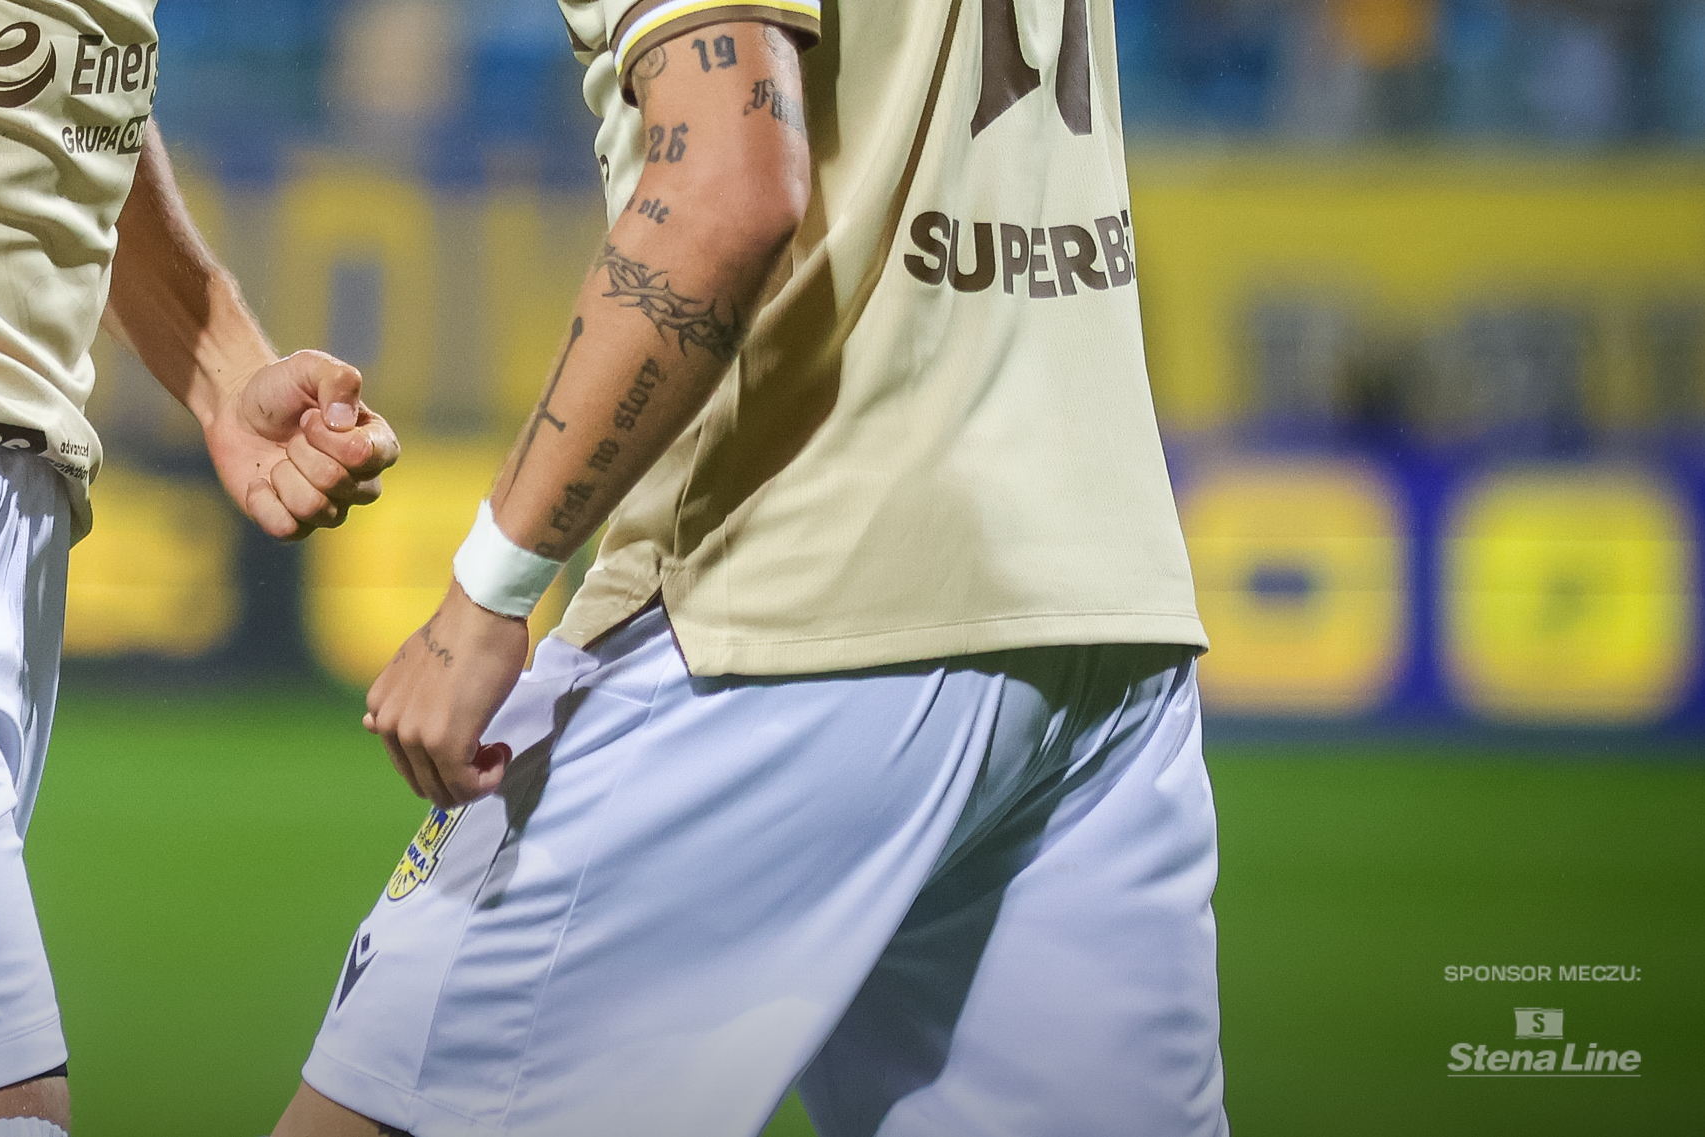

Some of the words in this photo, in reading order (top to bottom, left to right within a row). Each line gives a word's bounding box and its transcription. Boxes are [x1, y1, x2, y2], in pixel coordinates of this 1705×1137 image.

[70, 33, 157, 106] Ener
[691, 34, 737, 73] 19
[61, 126, 121, 154] GRUPA
[647, 123, 689, 164] 26
[903, 209, 1136, 299] SUPERB
[613, 358, 667, 432] story
